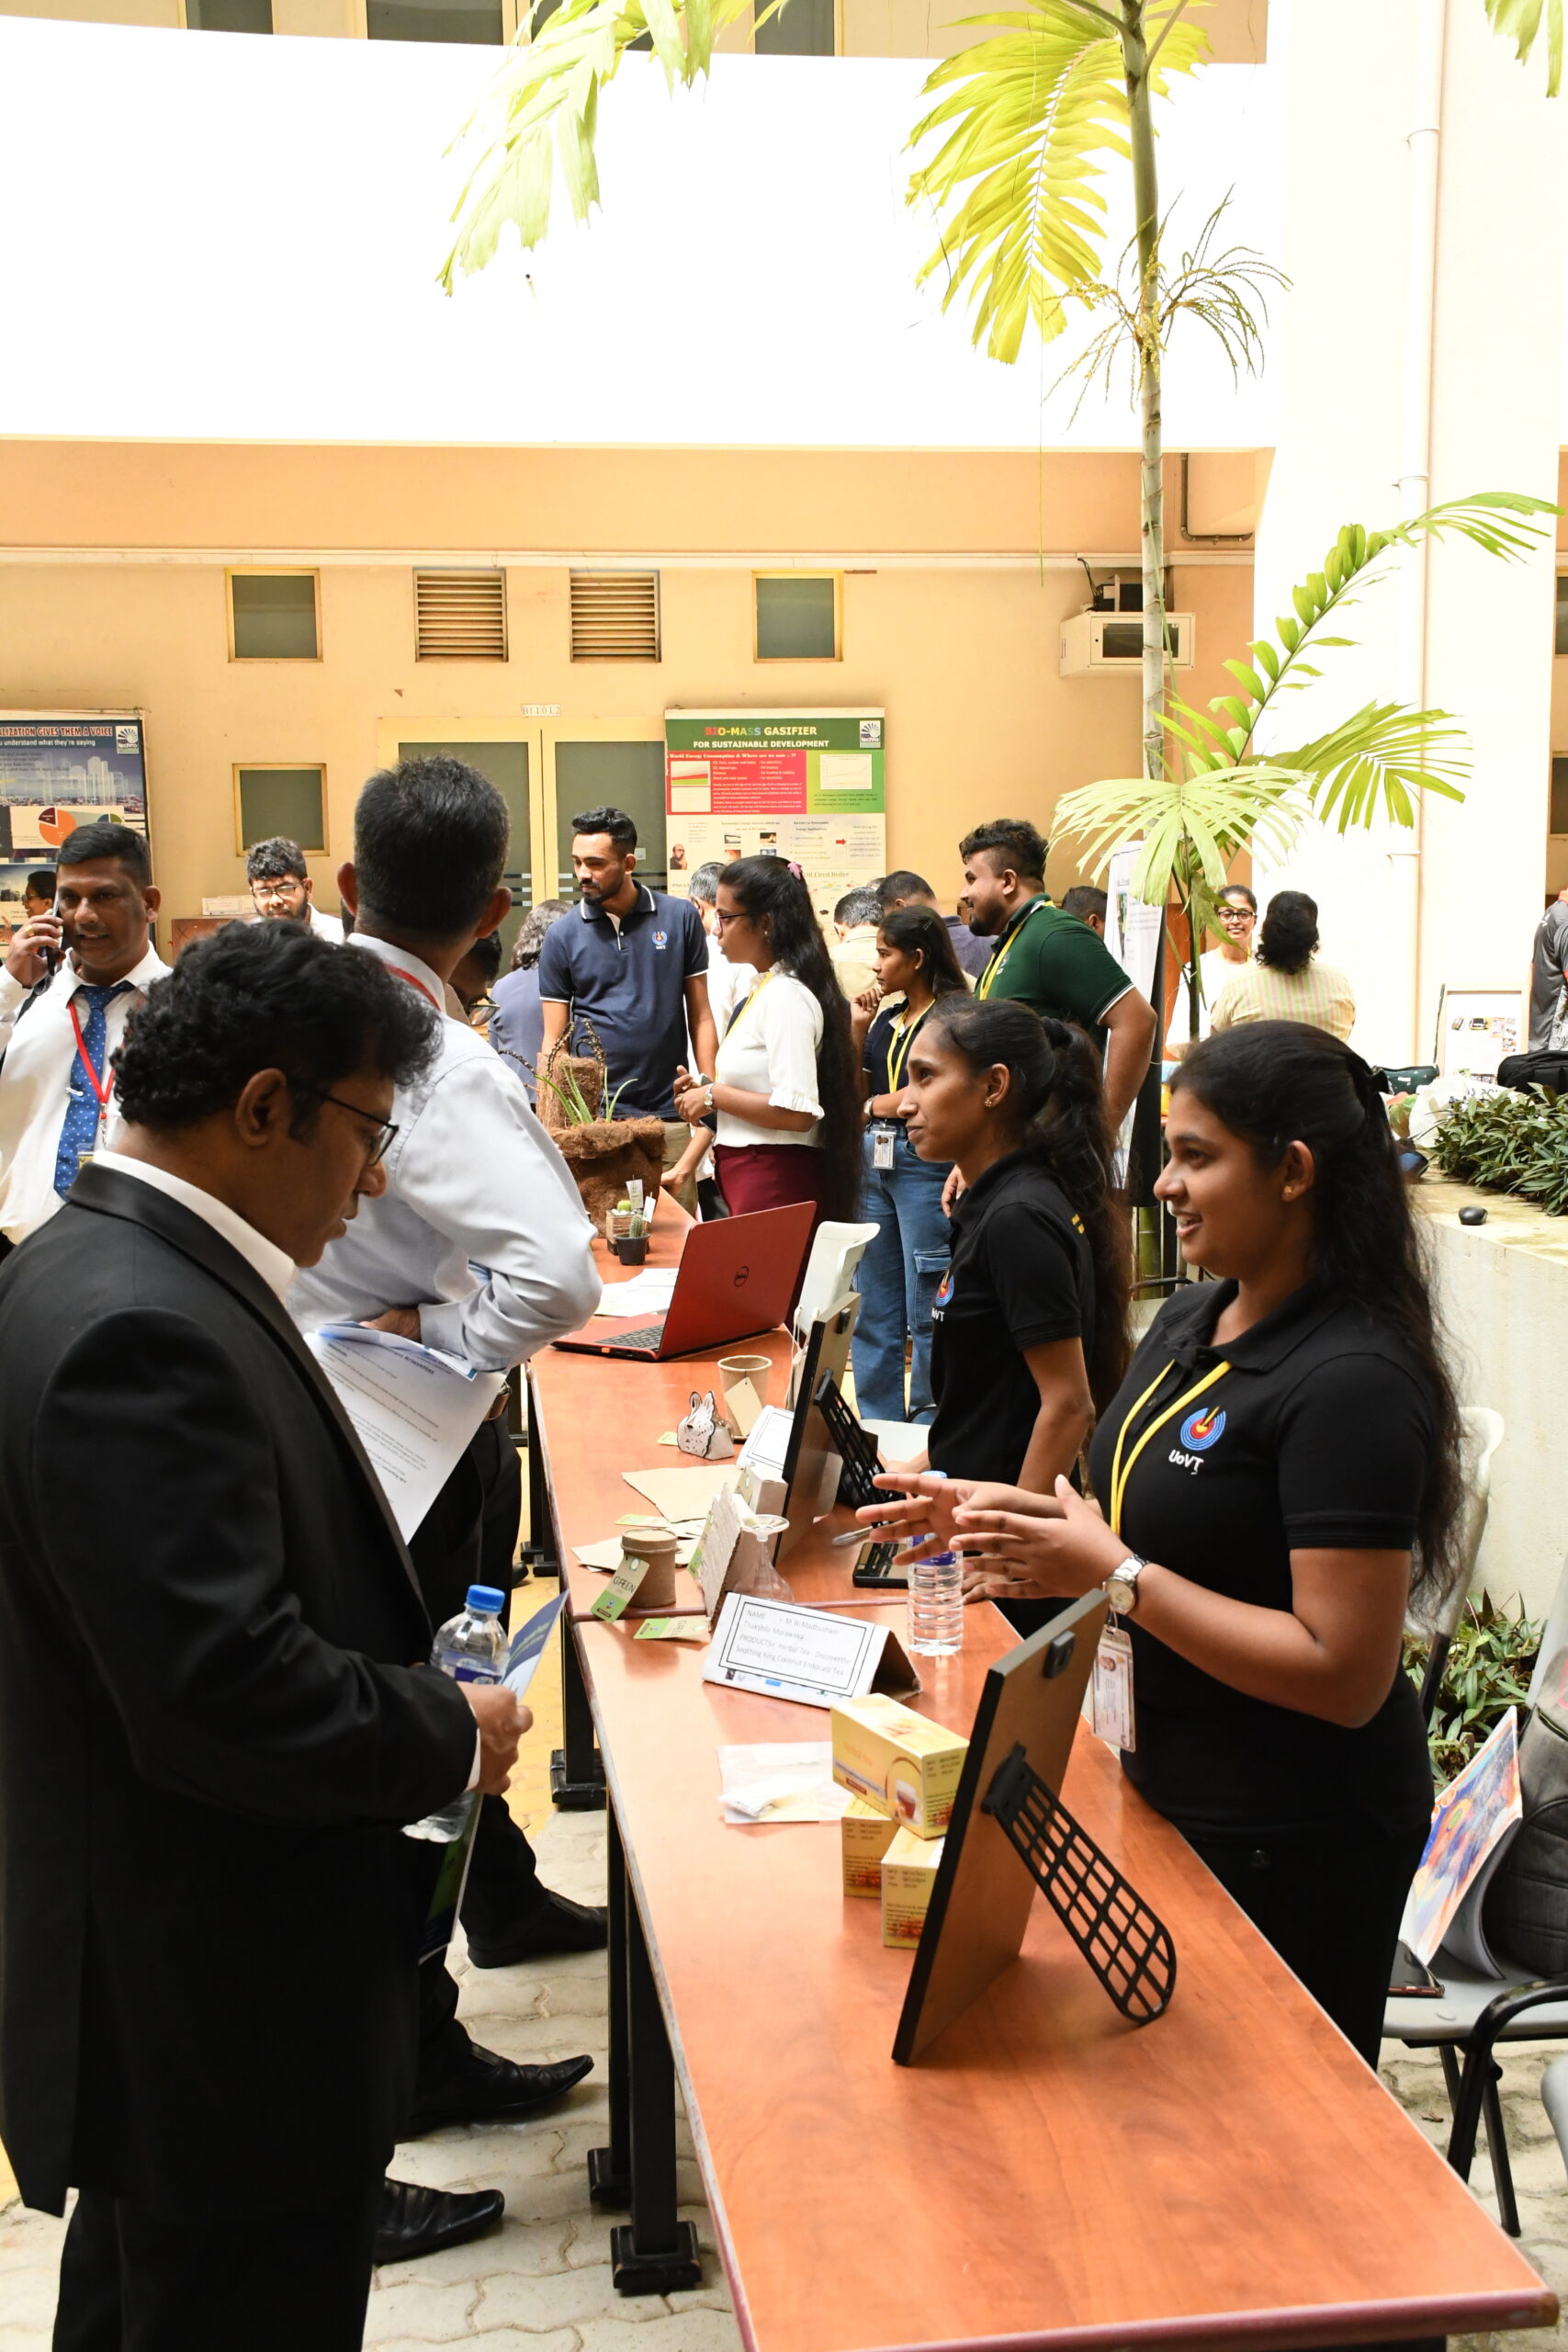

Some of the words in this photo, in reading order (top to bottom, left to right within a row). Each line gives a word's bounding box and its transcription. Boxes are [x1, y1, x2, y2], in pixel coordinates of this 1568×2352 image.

[38, 727, 60, 736] GIVES
[61, 727, 82, 736] THEM
[84, 727, 89, 736] A
[90, 727, 112, 736] VOICE
[705, 727, 761, 736] BIO-MASS
[764, 727, 818, 736] GASIFIER
[54, 739, 75, 747] they're
[770, 740, 829, 748] DEVELOPMENT
[1168, 1448, 1204, 1475] UoVT
[613, 1575, 637, 1594] GREEN
[762, 1648, 776, 1662] King
[776, 1653, 803, 1668] Coconut
[832, 1666, 844, 1676] Tea
